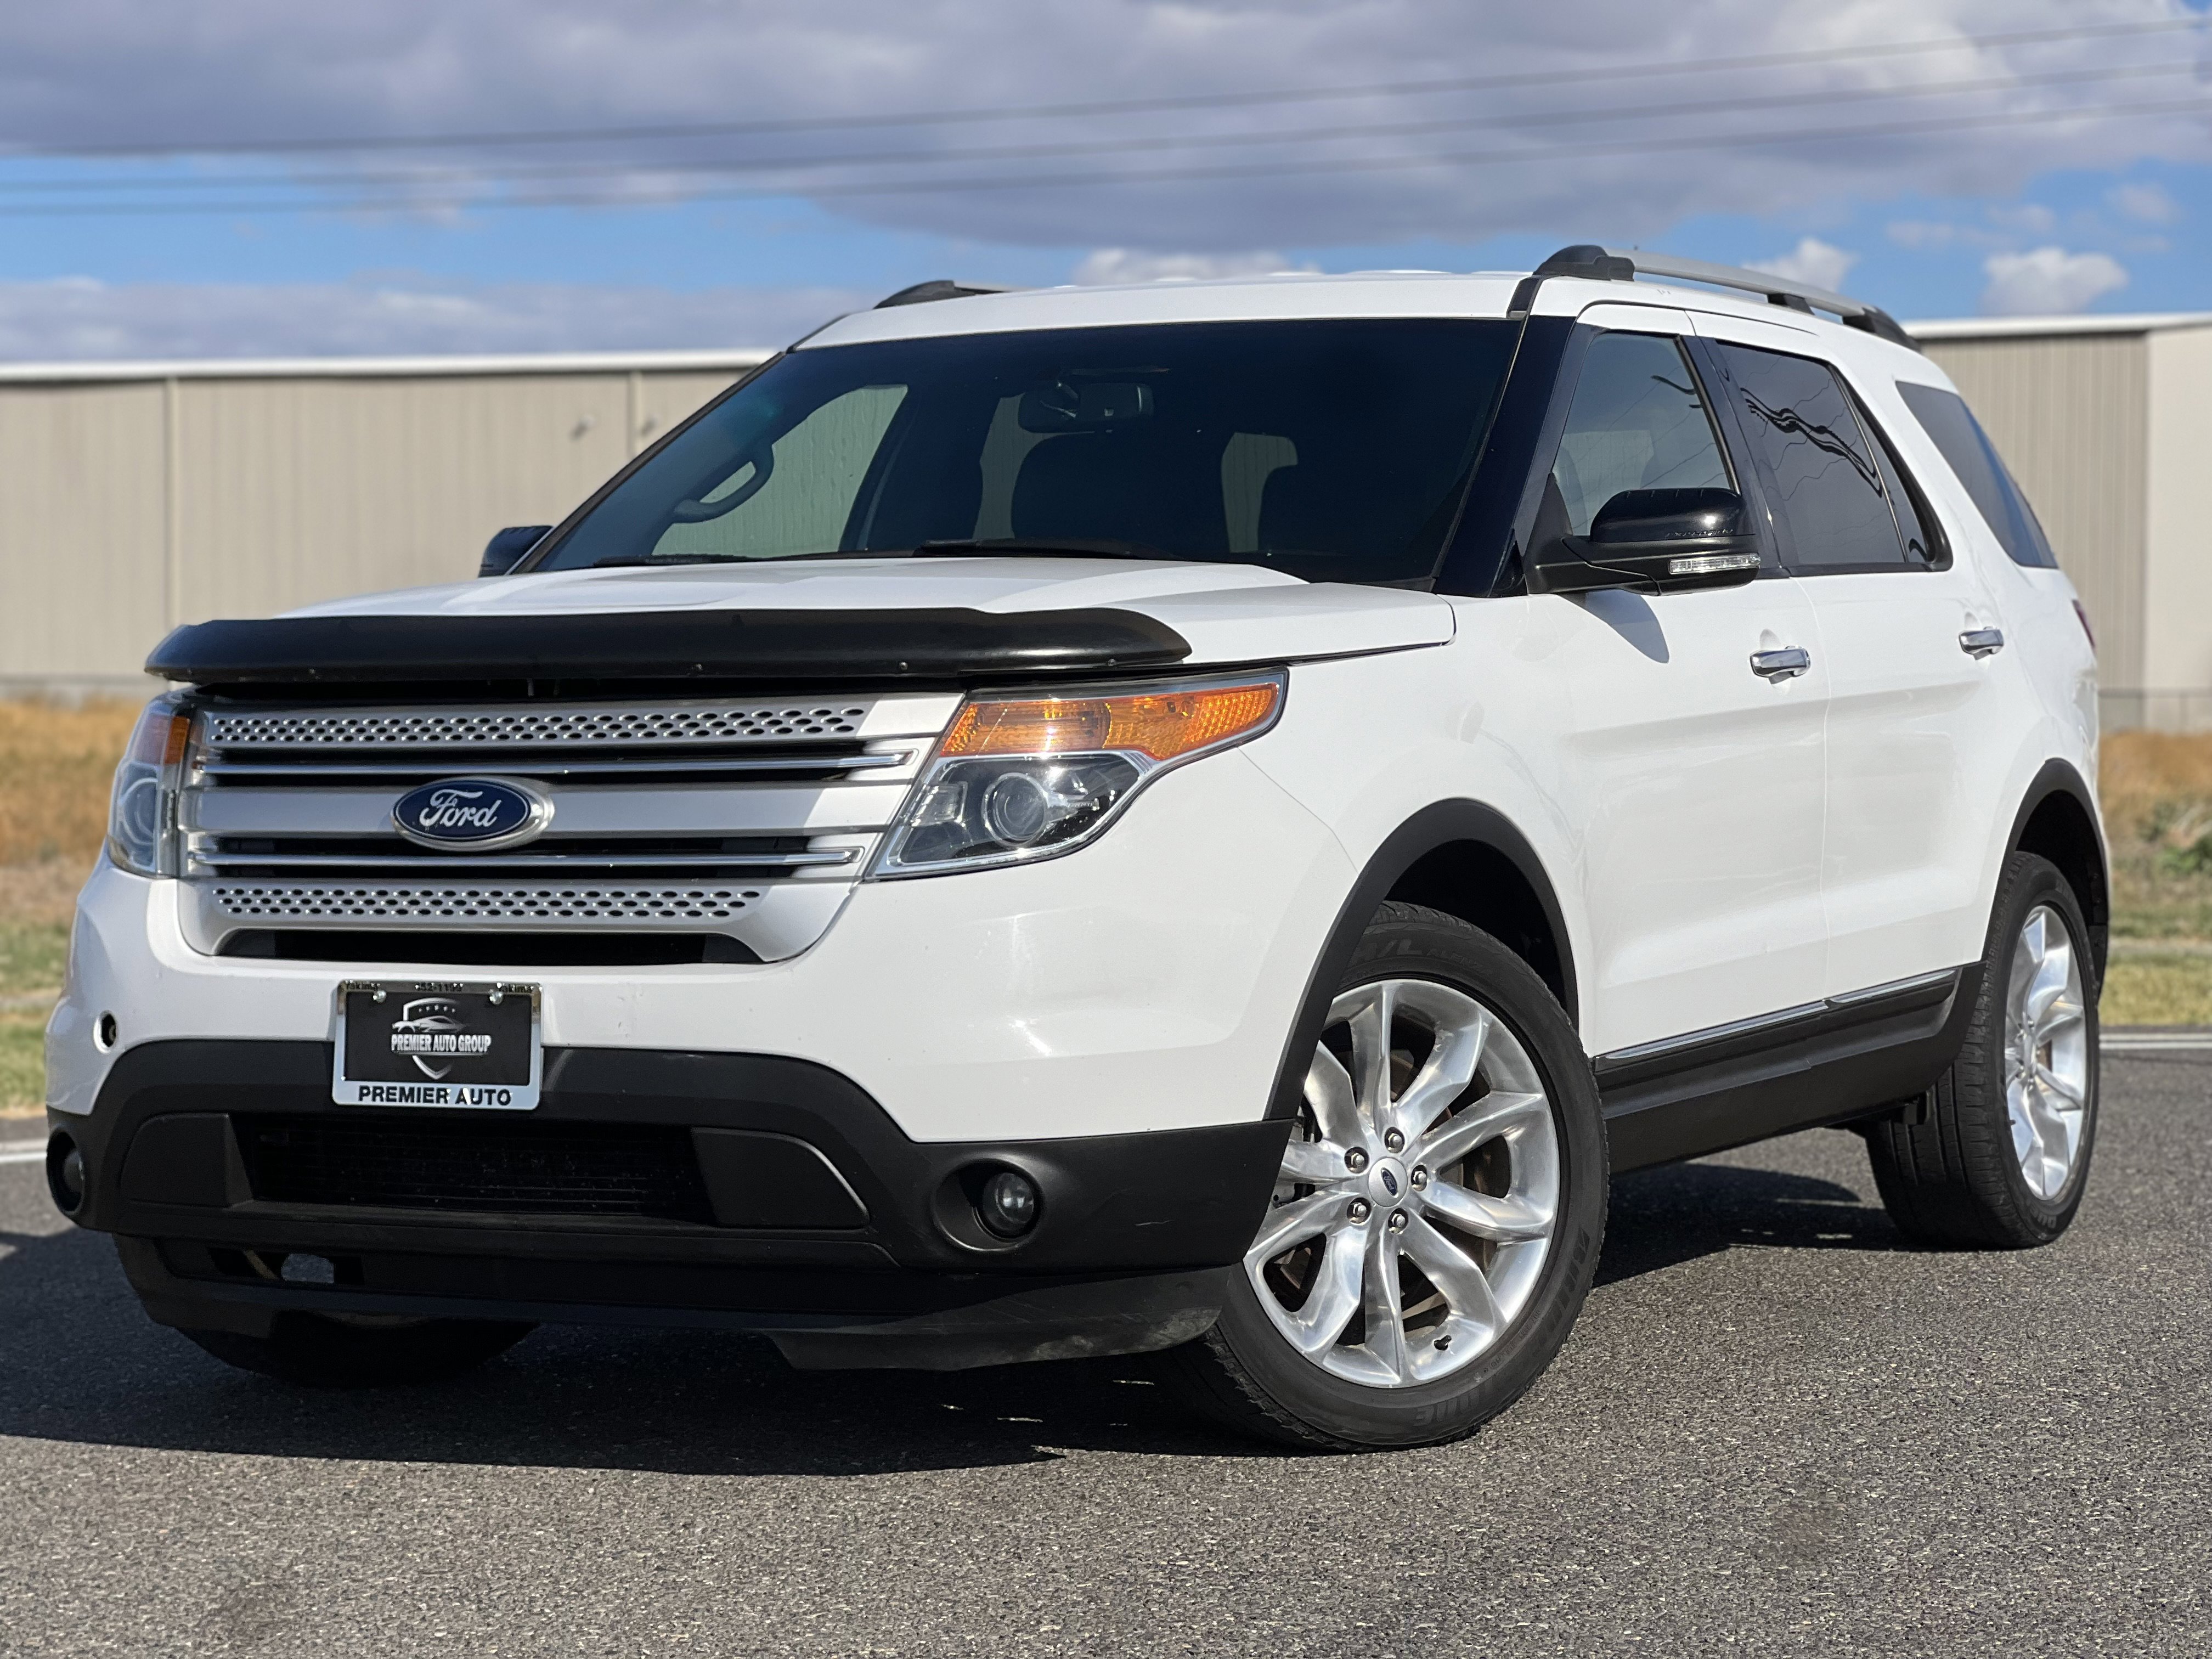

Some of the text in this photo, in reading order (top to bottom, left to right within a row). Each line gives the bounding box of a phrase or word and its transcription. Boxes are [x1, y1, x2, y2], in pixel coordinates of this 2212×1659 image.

[419, 789, 501, 828] Ford
[391, 1034, 491, 1052] PREMIER AUTO GROUP
[358, 1085, 511, 1105] PREMIER AUTO
